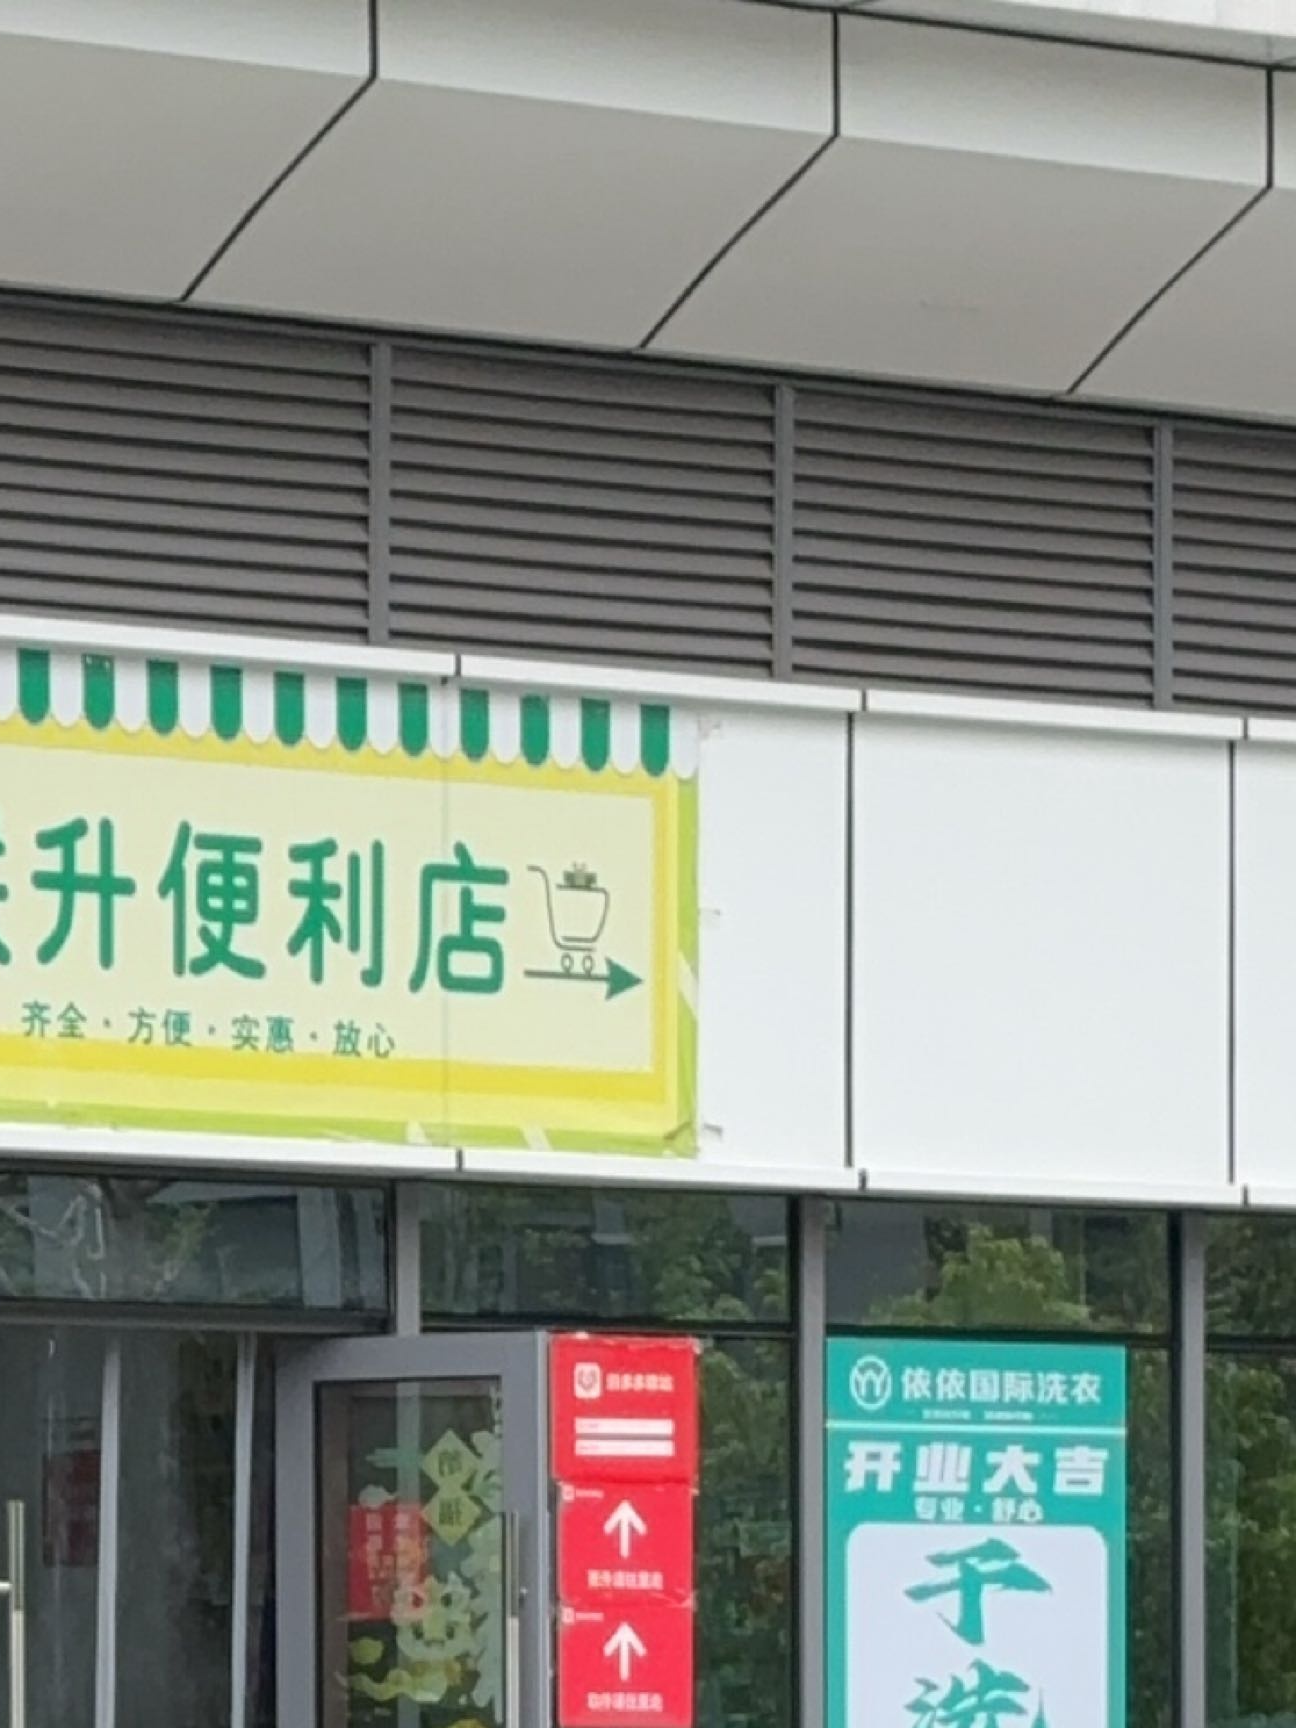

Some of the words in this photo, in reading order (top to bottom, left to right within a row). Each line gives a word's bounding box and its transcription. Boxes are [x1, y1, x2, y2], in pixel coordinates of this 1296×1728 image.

[901, 1367, 1102, 1405] 依依国际洗衣
[844, 1440, 1109, 1495] 开业大吉
